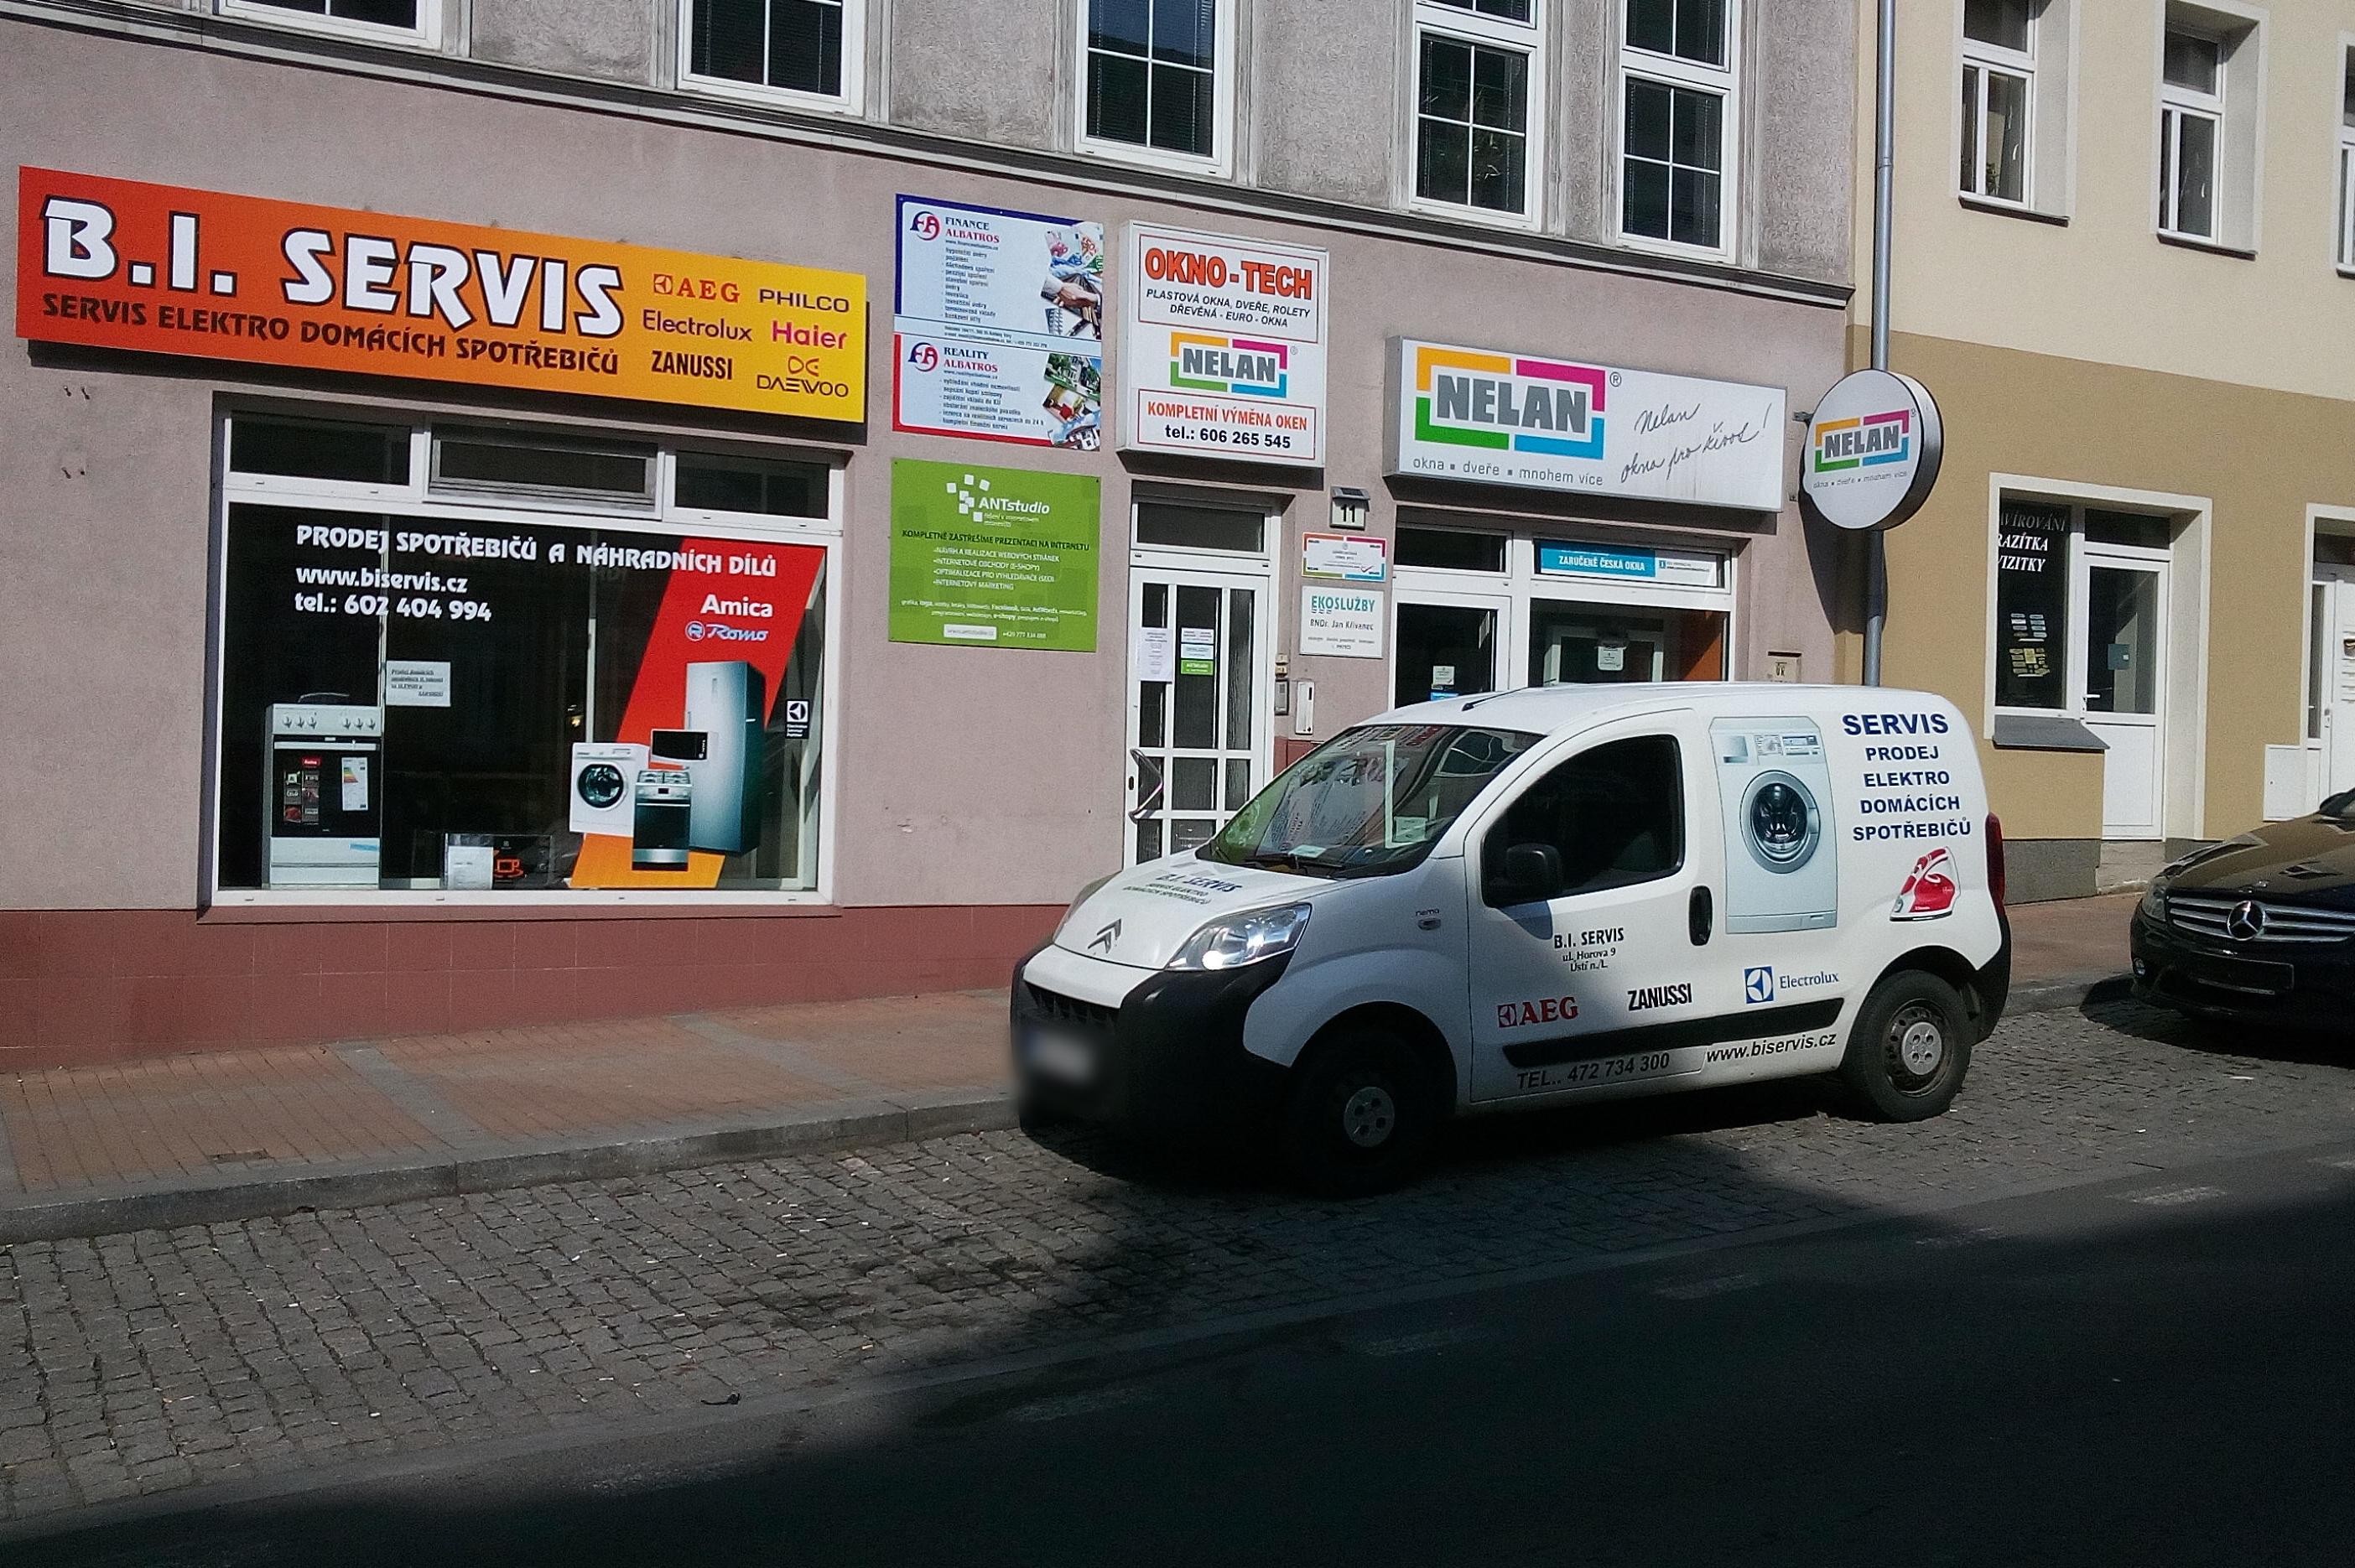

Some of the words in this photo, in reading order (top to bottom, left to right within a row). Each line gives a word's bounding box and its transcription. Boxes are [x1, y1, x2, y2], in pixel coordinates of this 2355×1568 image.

[945, 216, 990, 231] FINANCE
[945, 229, 1000, 243] ALBATROS
[40, 195, 237, 297] B.I.
[282, 226, 626, 339] SERVIS
[1145, 247, 1313, 300] OKNO-TECH
[677, 278, 740, 303] AEG
[759, 288, 850, 313] PHILCO
[1146, 288, 1199, 304] PLASTOVÁ
[1203, 295, 1231, 309] OKNA,
[1235, 299, 1270, 314] DVEŘE,
[1272, 305, 1310, 318] ROLETY
[1170, 304, 1217, 319] DŘEVĚNÁ
[1225, 311, 1253, 323] EURO
[1261, 315, 1288, 327] OKNA
[43, 293, 148, 325] SERVIS
[159, 305, 289, 341] ELEKTRO
[301, 321, 445, 358] DOMÁCÍCH
[456, 338, 619, 375] SPOTŘEBIČŮ
[643, 309, 752, 341] Electrolux
[772, 320, 848, 349] Haier
[944, 347, 989, 360] REALITY
[944, 359, 998, 372] ALBATROS
[1183, 347, 1276, 382] NELAN
[652, 350, 733, 380] ZANUSSI
[756, 375, 849, 397] DAEWOO
[1147, 401, 1219, 423] KOMPLETNÍ
[1222, 406, 1272, 428] VÝMĚNA
[1276, 415, 1307, 430] OKEN
[1437, 374, 1587, 434] NELAN
[1635, 403, 1701, 434] Nelan
[1165, 423, 1195, 440] tel.:
[1200, 428, 1227, 443] 606
[1232, 431, 1259, 445] 265
[1264, 434, 1291, 449] 545
[1825, 424, 1900, 459] NELAN
[1413, 457, 1444, 471] okna
[1463, 459, 1500, 476] dveře
[1519, 467, 1573, 484] mnohem
[1578, 472, 1603, 486] více
[1621, 457, 1666, 483] okna
[1666, 447, 1703, 480] pro
[979, 497, 1050, 514] ANTstudio
[1341, 503, 1355, 523] 11
[296, 525, 389, 555] PRODEJ
[396, 530, 538, 560] SPOTŘEBIČŮ
[548, 543, 564, 563] A
[577, 541, 722, 574] NÁHRADNÍCH
[729, 549, 777, 577] DÍLŮ
[1039, 540, 1049, 548] NA
[1050, 541, 1089, 551] INTERNETU
[1625, 560, 1645, 571] OKNA
[296, 565, 468, 593] www.biservis.cz
[294, 593, 337, 614] tel.:
[344, 594, 389, 615] 602
[396, 597, 442, 619] 404
[450, 601, 492, 622] 994
[700, 594, 773, 618] Amica
[1311, 596, 1375, 613] EKOSLUŽBY
[705, 623, 769, 641] Romo
[1842, 714, 1949, 735] SERVIS
[1865, 745, 1939, 761] PRODEJ
[1864, 771, 1950, 787] ELEKTRO
[1860, 794, 1961, 814] DOMÁCÍCH
[1853, 817, 1971, 841] SPOTŘEBIČŮ
[1554, 933, 1576, 948] B.I.
[1582, 927, 1624, 946] SERVIS
[1570, 960, 1588, 972] Ústí
[1577, 950, 1608, 960] Horova
[1610, 948, 1616, 956] 9
[1779, 972, 1839, 989] Electrolux
[1627, 983, 1692, 1011] ZANUSSI
[1521, 997, 1578, 1026] AEG
[1707, 1033, 1837, 1062] www.biservis.cz
[1567, 1063, 1599, 1082] 472
[1605, 1057, 1634, 1077] 734
[1640, 1052, 1669, 1072] 300
